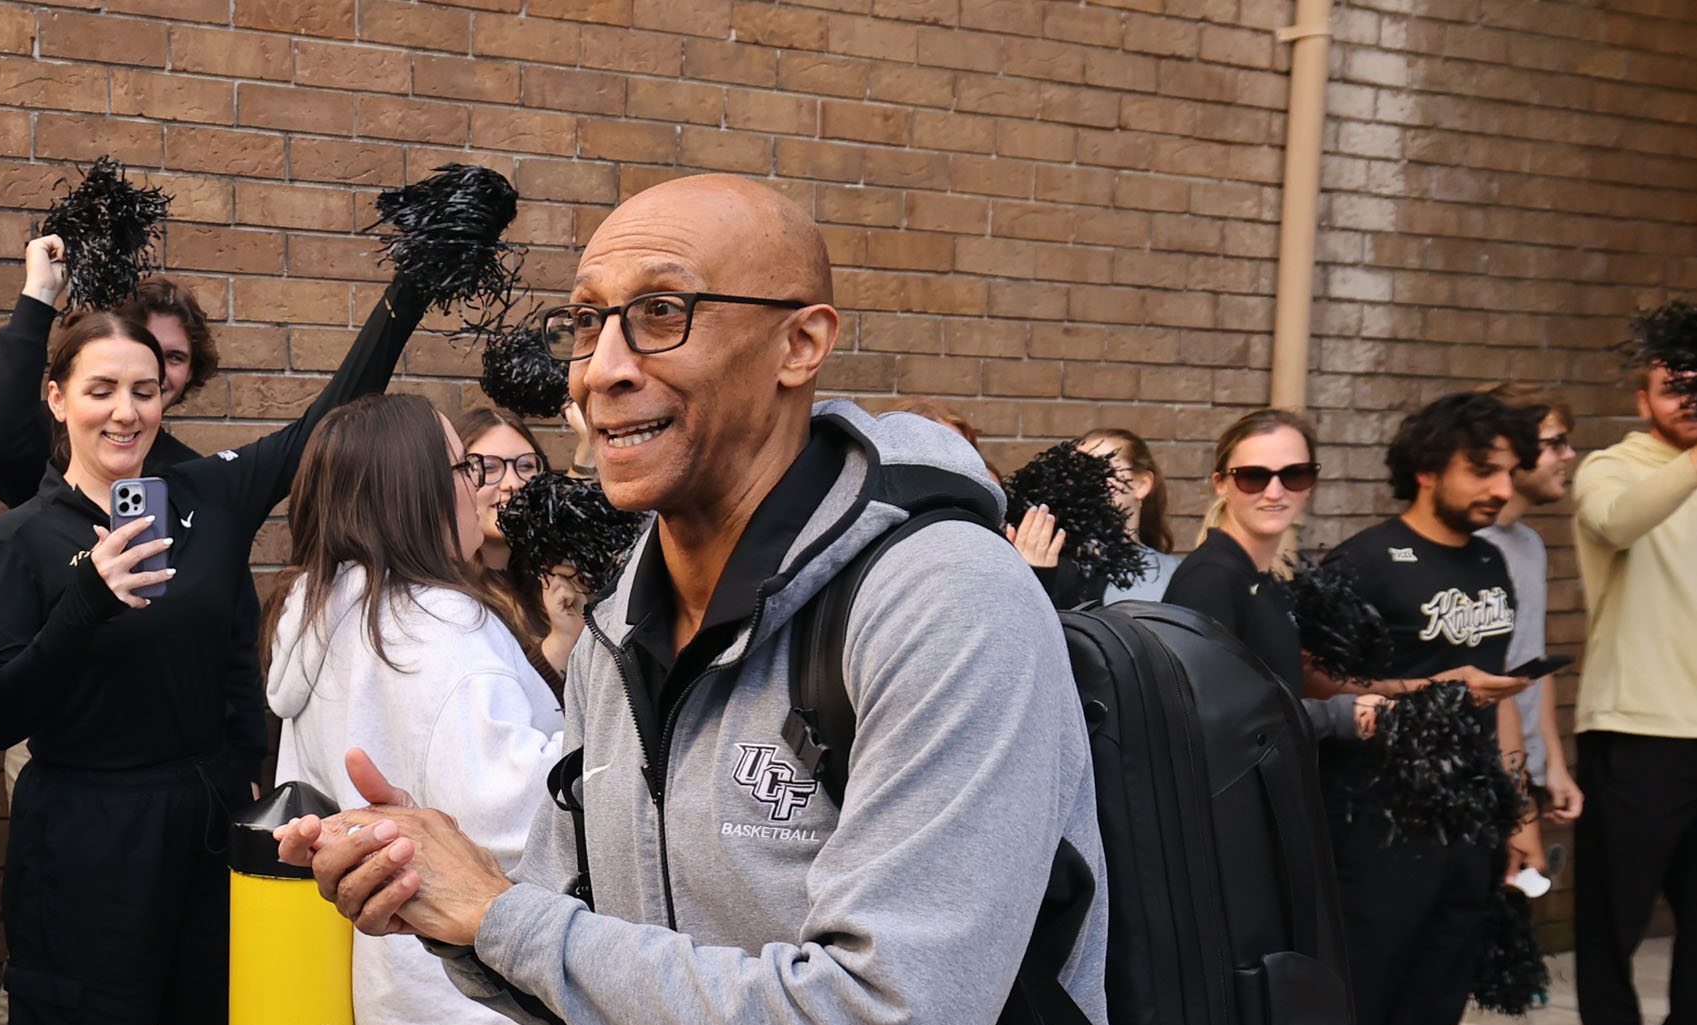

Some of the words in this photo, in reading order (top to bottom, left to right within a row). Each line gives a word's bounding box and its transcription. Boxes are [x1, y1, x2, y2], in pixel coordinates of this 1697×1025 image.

[1419, 587, 1514, 647] Knights
[733, 742, 819, 822] UCF
[721, 823, 820, 842] BASKETBALL
